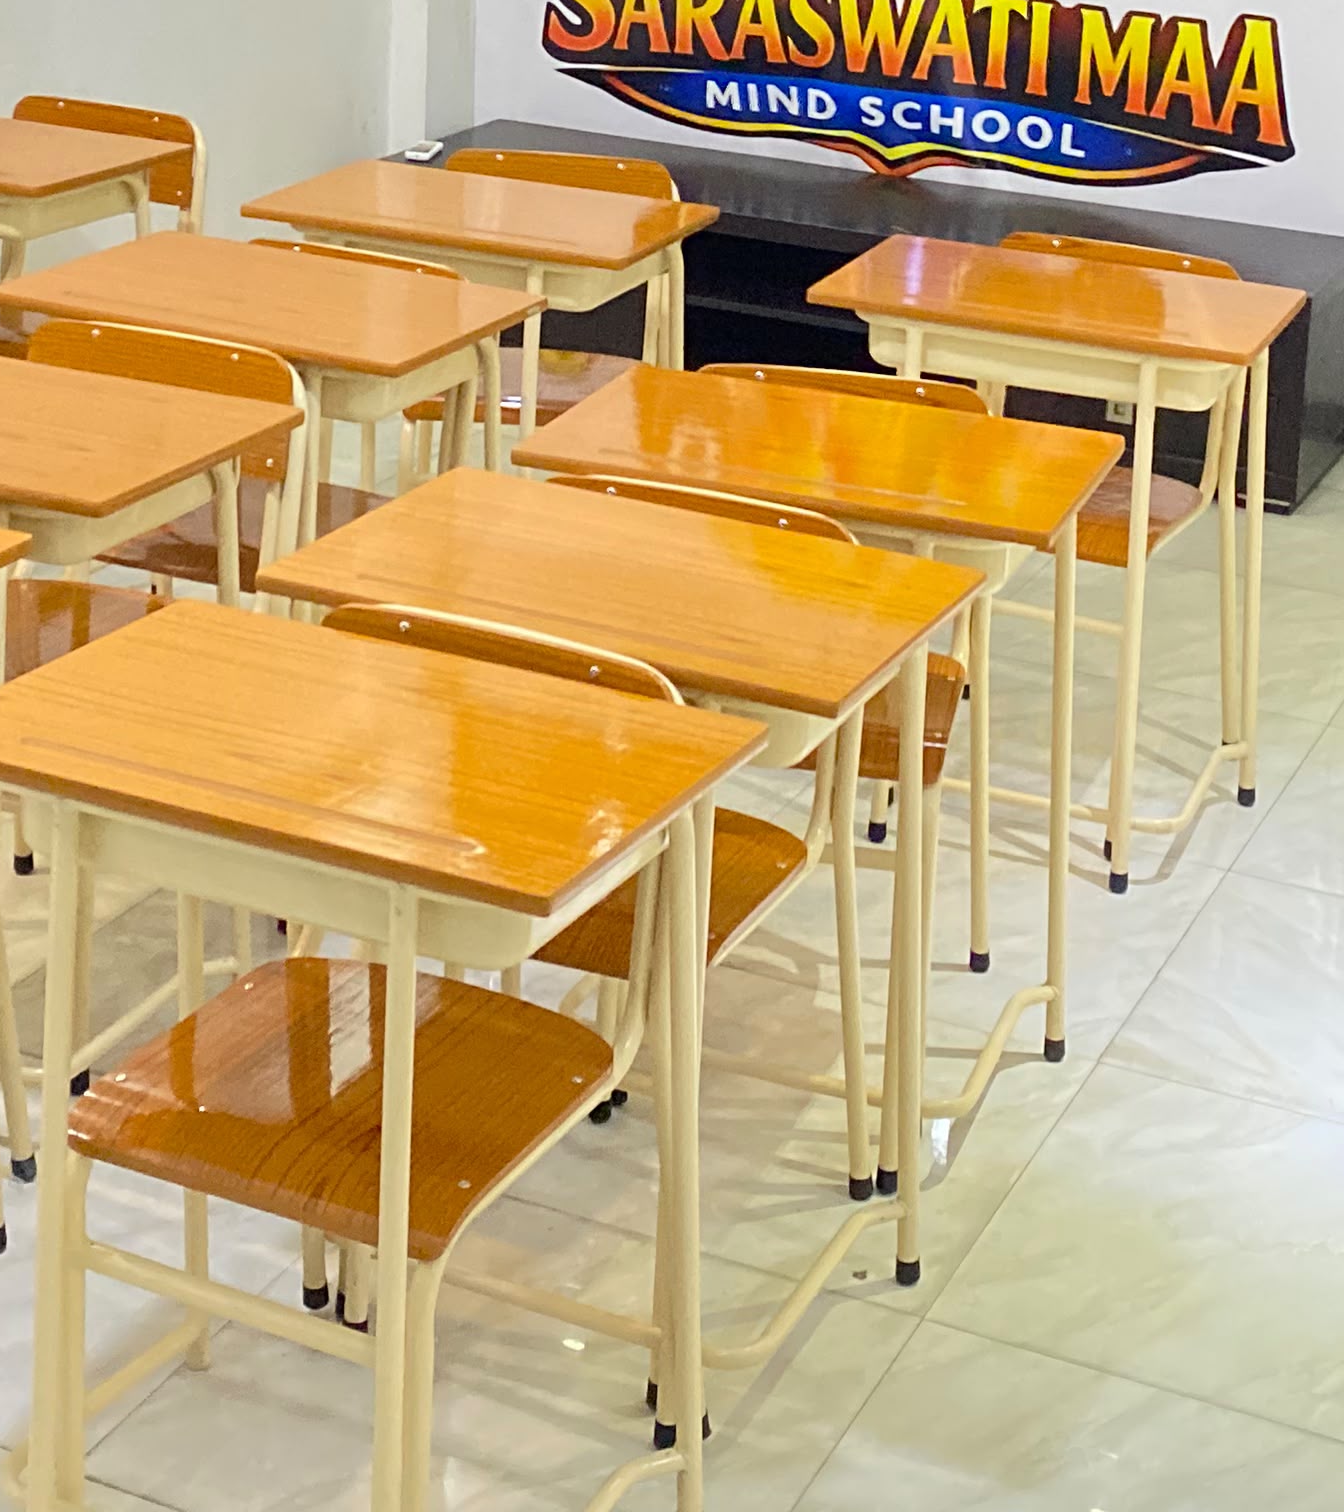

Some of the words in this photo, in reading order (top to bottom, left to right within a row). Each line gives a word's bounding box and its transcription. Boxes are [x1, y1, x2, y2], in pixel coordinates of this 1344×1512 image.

[704, 78, 839, 125] MIND
[858, 93, 1086, 160] SCHOOL
[1076, 9, 1290, 149] MAA
